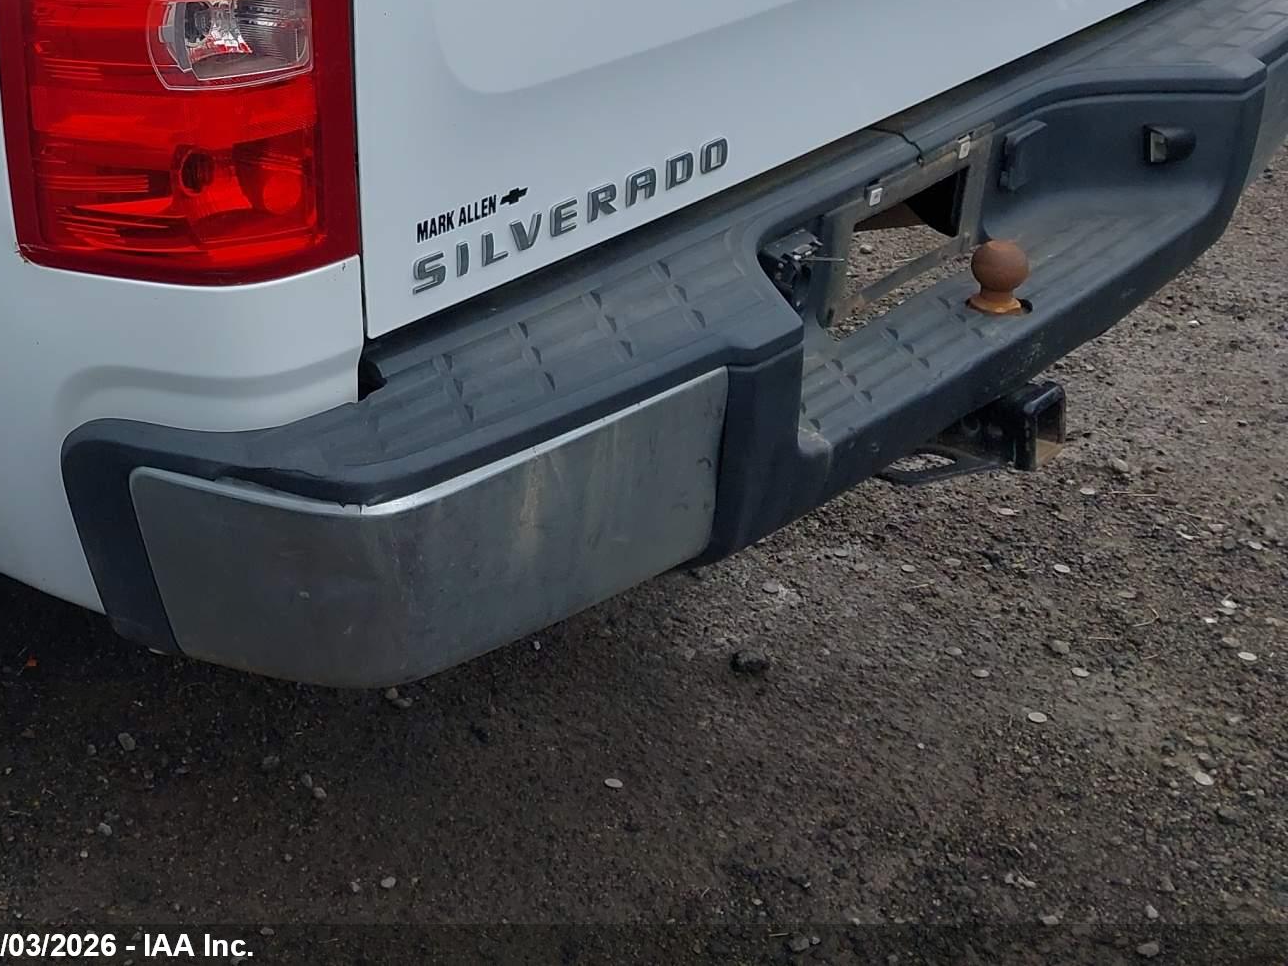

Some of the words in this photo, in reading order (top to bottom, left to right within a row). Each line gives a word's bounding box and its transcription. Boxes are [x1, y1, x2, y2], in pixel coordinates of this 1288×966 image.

[412, 136, 729, 295] SILVERADO
[416, 210, 455, 243] MARK
[458, 194, 497, 227] ALLEN
